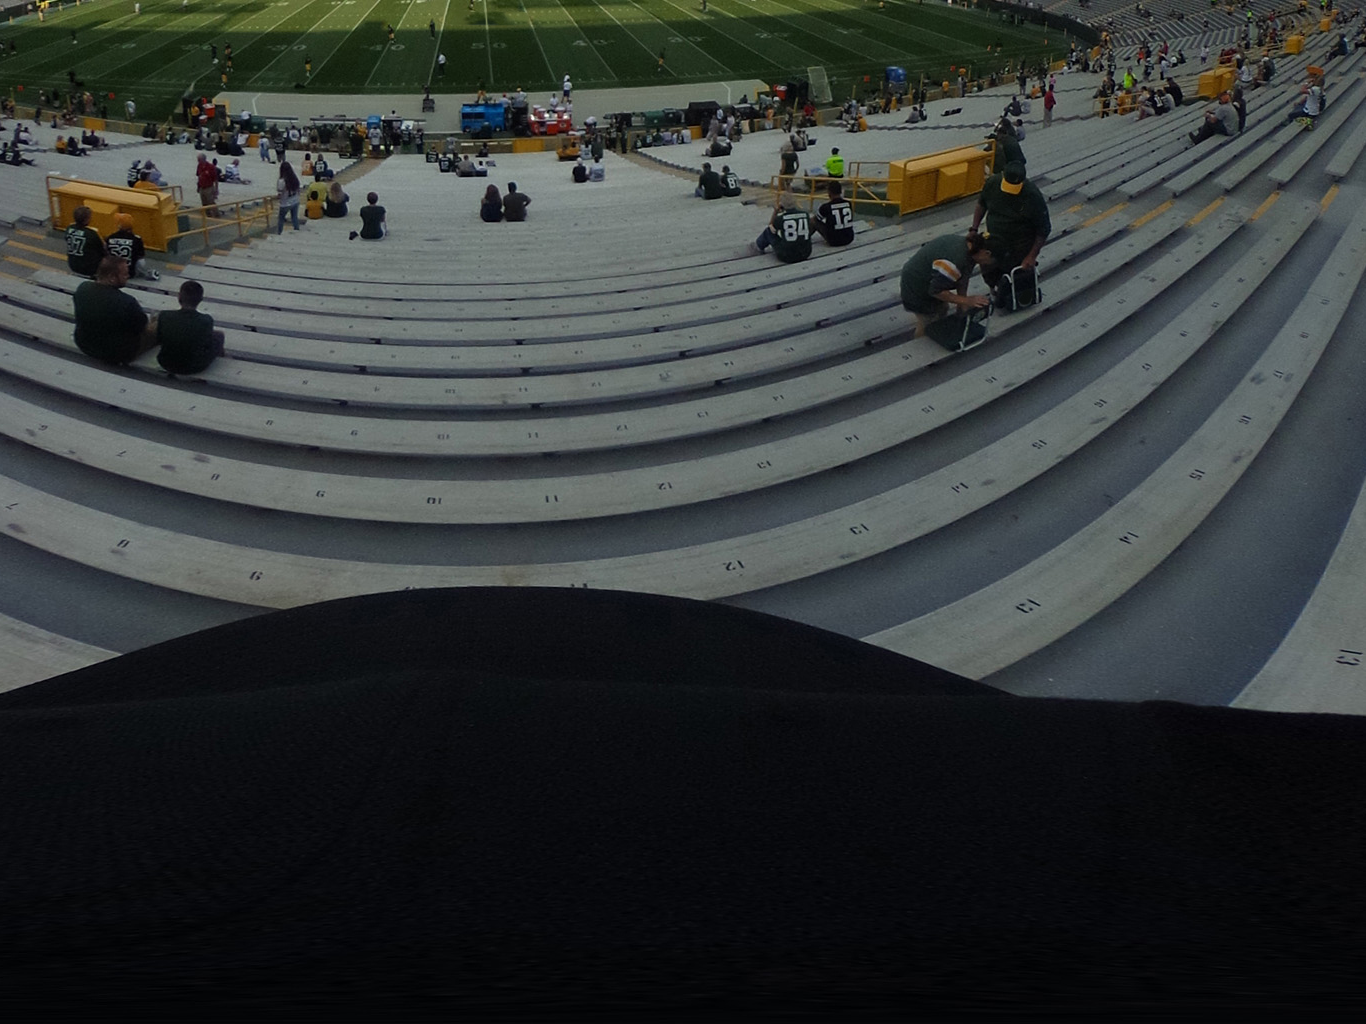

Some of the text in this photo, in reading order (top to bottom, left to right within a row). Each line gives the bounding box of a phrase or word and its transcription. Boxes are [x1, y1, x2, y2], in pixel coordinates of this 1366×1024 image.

[832, 208, 854, 230] 12
[783, 218, 810, 242] 84
[657, 481, 673, 491] 12
[950, 481, 970, 494] 14
[426, 496, 442, 505] 10
[544, 494, 559, 504] 11
[848, 523, 870, 536] 13
[1118, 531, 1140, 545] 14
[722, 559, 745, 572] 12
[1015, 598, 1042, 614] 13
[1335, 648, 1364, 667] 13
